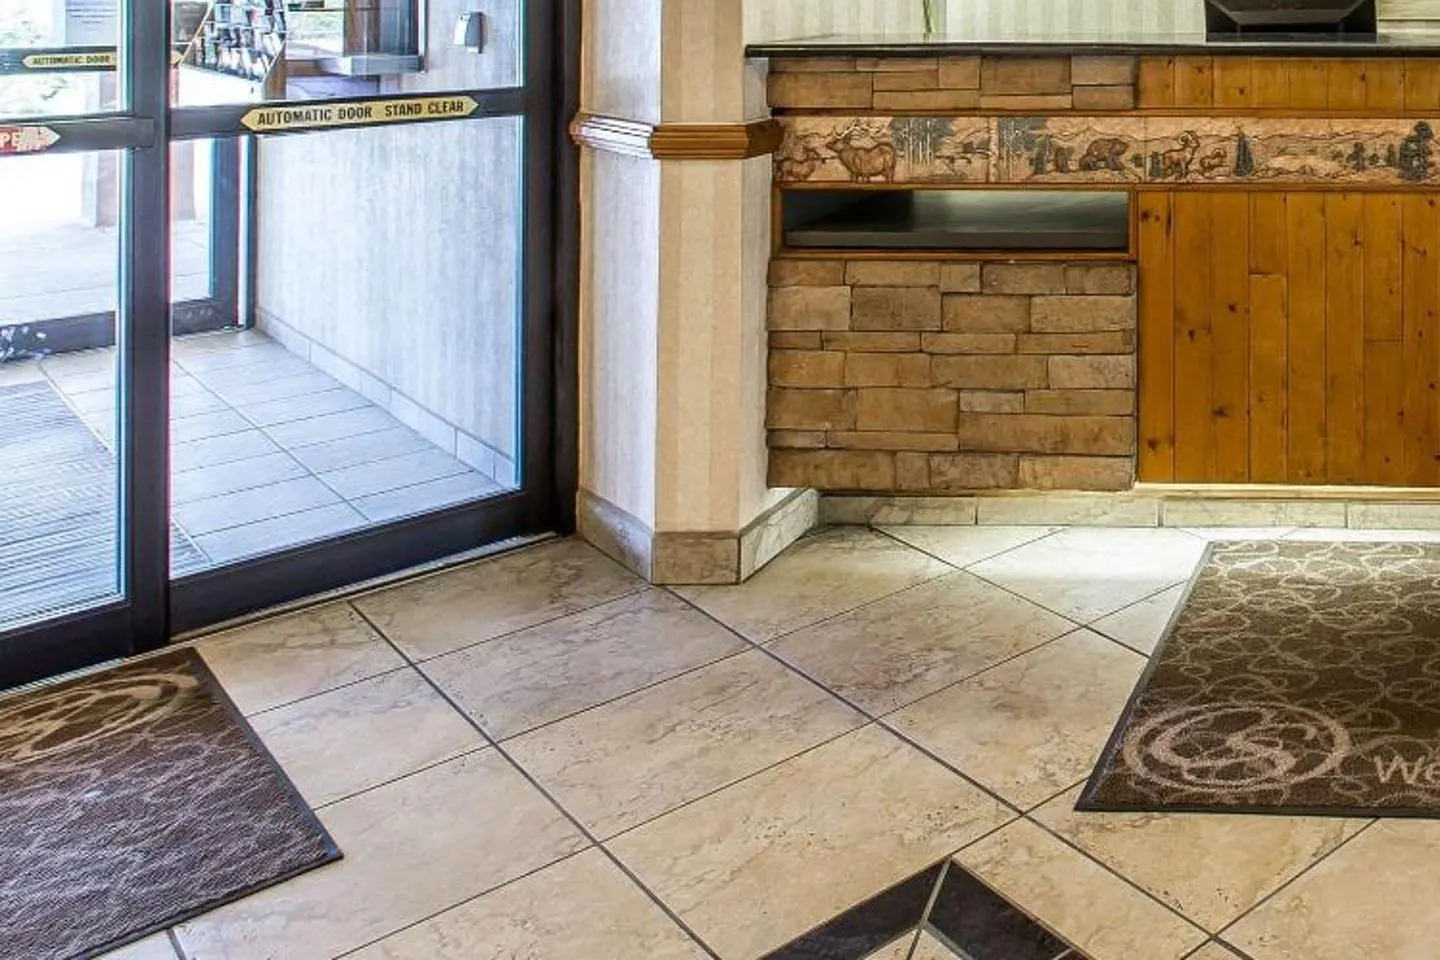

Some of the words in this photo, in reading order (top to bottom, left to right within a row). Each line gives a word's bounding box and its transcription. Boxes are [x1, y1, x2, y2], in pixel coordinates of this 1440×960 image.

[32, 56, 82, 65] AUTOMATIC
[86, 55, 110, 64] DOOR
[257, 109, 332, 125] AUTOMATIC
[338, 106, 372, 120] DOOR
[385, 102, 422, 117] STAND
[428, 100, 464, 114] CLEAR
